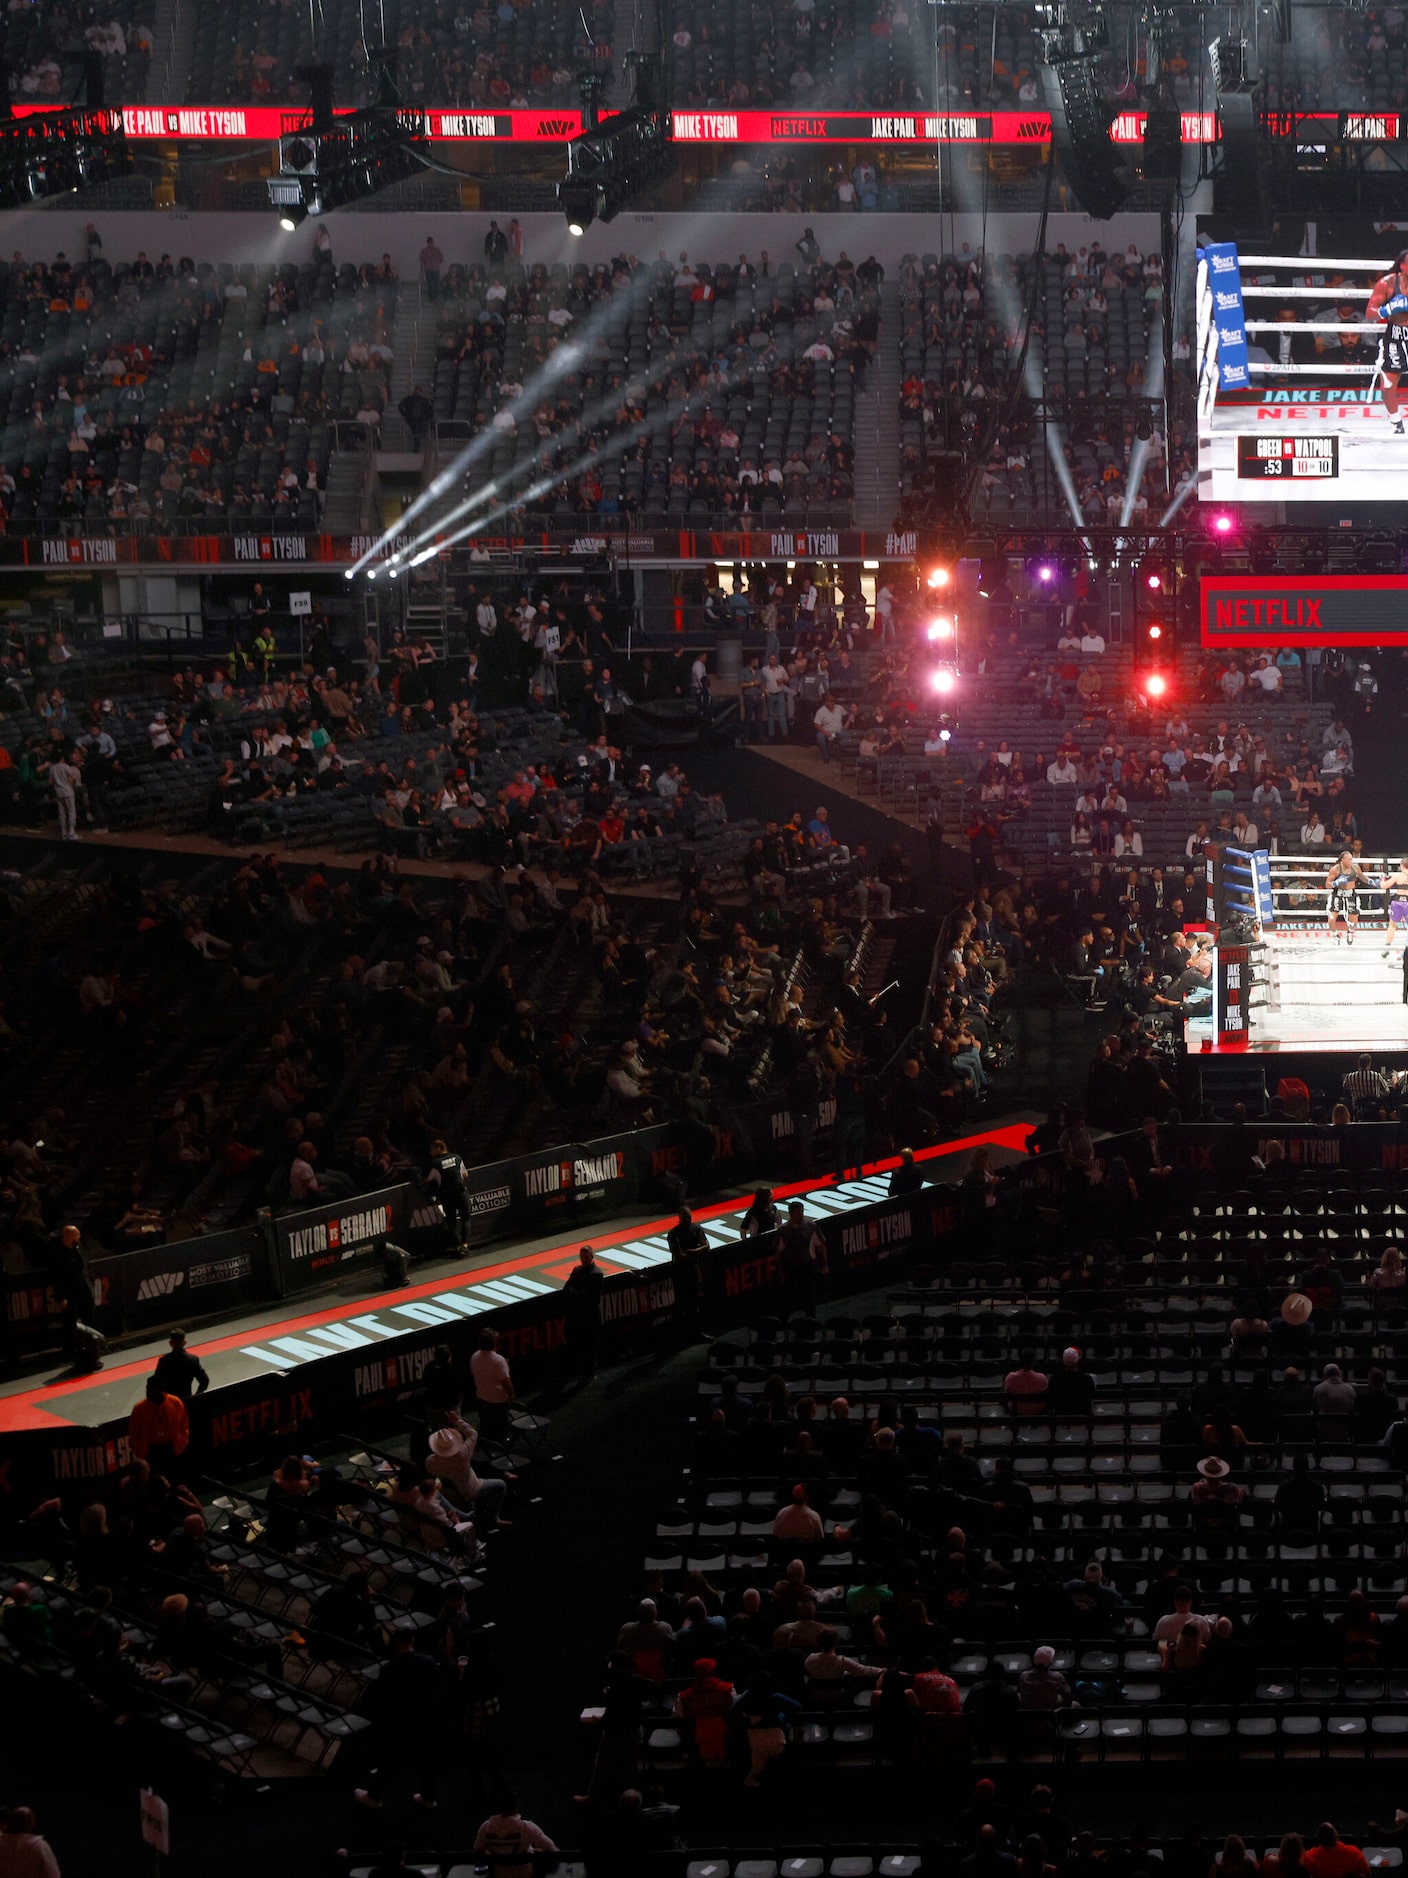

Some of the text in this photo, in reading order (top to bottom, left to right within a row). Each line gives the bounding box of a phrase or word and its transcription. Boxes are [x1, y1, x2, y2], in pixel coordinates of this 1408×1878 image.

[137, 111, 166, 135] PAUL
[179, 111, 208, 135] MIKE
[209, 111, 246, 135] TYSON
[441, 115, 464, 136] MIKE
[464, 115, 495, 136] TYSON
[674, 115, 738, 139] MIKE TYSON
[773, 119, 827, 137] NETFLIX
[871, 117, 977, 139] JAKE PAUL MIKE TYSON
[1263, 390, 1320, 402] JAKE
[1257, 438, 1282, 458] GREEN
[1294, 438, 1333, 458] WATPOOL
[1264, 459, 1329, 475] :53 10 10
[43, 539, 69, 563] PAUL
[81, 539, 116, 562] TYSON
[234, 537, 260, 560] PAUL
[272, 536, 306, 560] TYSON
[771, 534, 796, 556] PAUL
[807, 534, 839, 556] TYSON
[1216, 598, 1322, 629] NETFLIX
[1276, 923, 1305, 931] JAKE
[1227, 963, 1241, 977] JAKE
[1226, 976, 1242, 990] PAUL
[1226, 1004, 1241, 1018] MIKE
[1224, 1017, 1243, 1031] TYSON
[1302, 1138, 1340, 1164] TYSON
[525, 1164, 560, 1197] TAYLOR
[288, 1223, 327, 1260] TAYLOR
[329, 1227, 338, 1241] VS
[841, 1222, 868, 1257] PAUL
[880, 1209, 912, 1246] TYSON
[137, 1271, 184, 1301] MVP
[354, 1360, 385, 1399] PAUL
[210, 1388, 316, 1450] NETFLIX
[51, 1446, 104, 1481] TAYLOR
